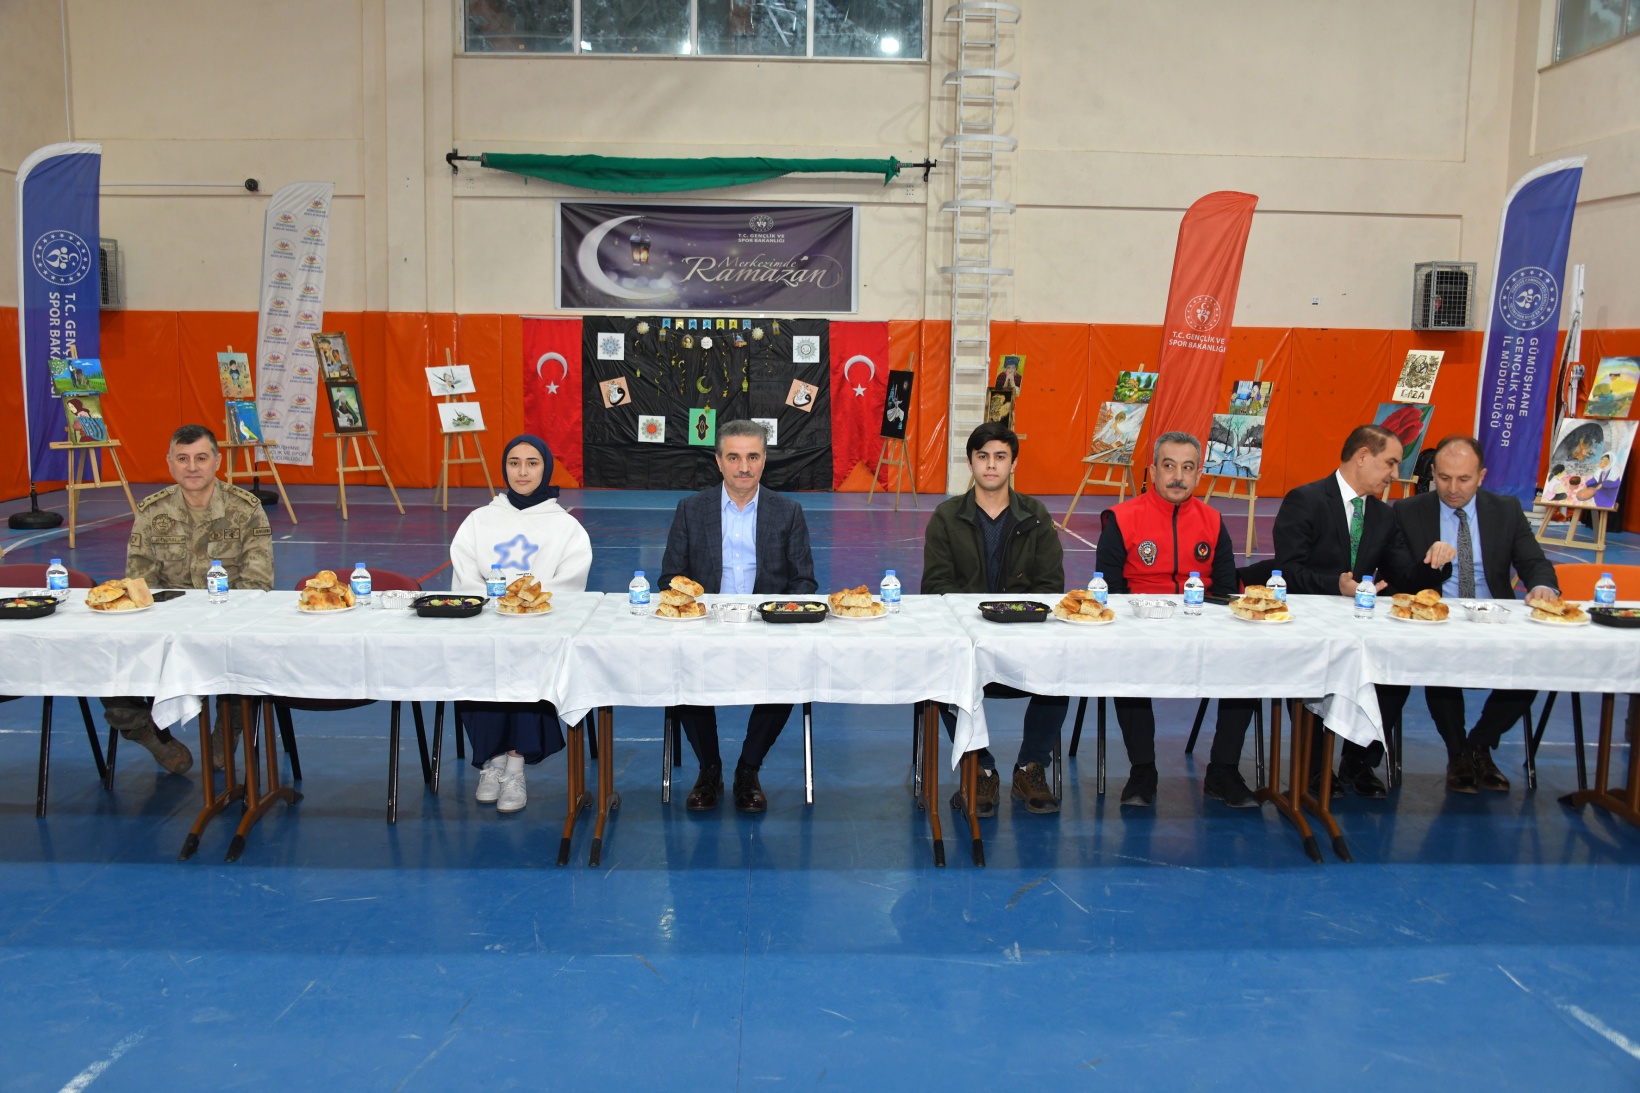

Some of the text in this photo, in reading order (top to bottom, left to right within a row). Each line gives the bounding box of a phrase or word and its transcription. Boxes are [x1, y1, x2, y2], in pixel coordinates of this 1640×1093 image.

[680, 254, 843, 289] Ramazan
[718, 253, 799, 268] Merkezimde
[49, 292, 60, 326] SPOR
[65, 293, 76, 316] T.C.
[1169, 339, 1226, 353] SPOR BAKANLIĞI
[1172, 331, 1225, 345] T.C. GENÇLİK VE
[1490, 335, 1513, 428] İL MÜDÜRLÜĞÜ
[1519, 337, 1539, 417] GÜMÜŞHANE
[1401, 389, 1425, 400] GAZA
[1506, 395, 1516, 410] VE
[1500, 413, 1513, 447] SPOR
